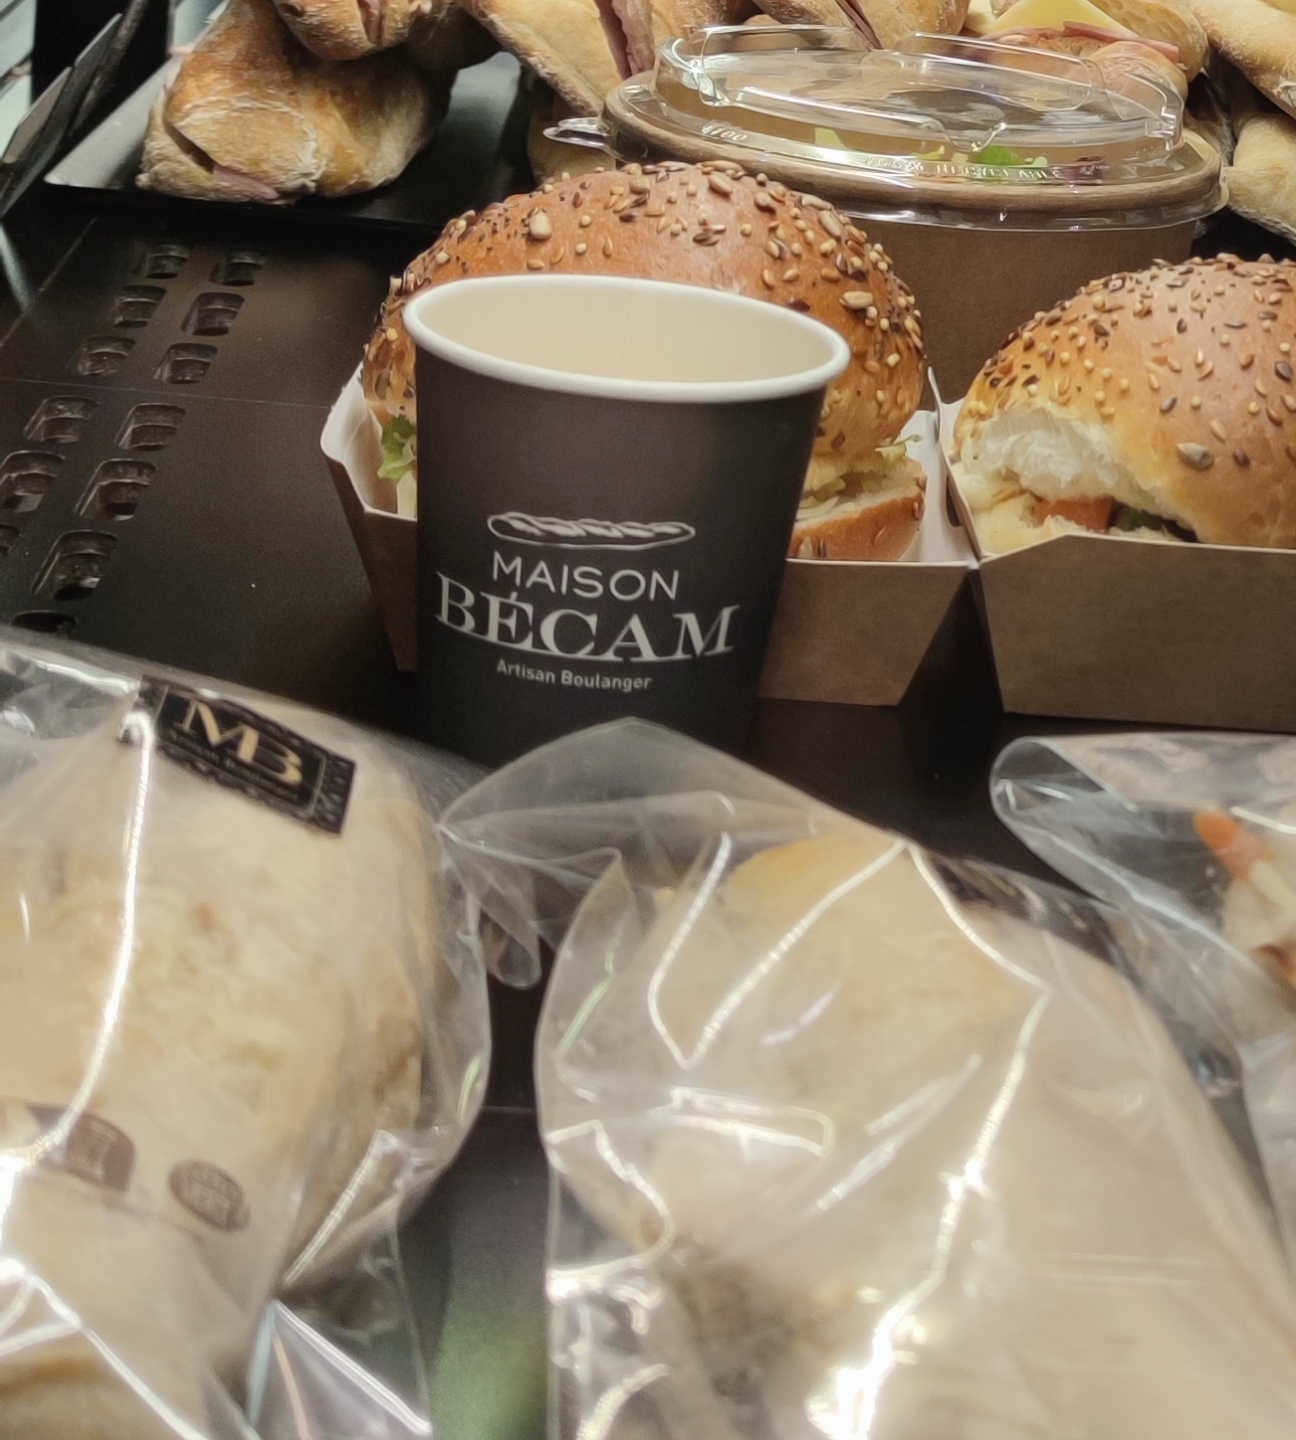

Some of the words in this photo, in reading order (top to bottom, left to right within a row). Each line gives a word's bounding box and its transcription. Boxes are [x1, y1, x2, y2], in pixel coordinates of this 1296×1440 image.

[493, 550, 680, 601] MAISON
[436, 572, 741, 662] BÉCAM
[497, 659, 556, 685] Artisan
[560, 670, 653, 693] Boulanger
[172, 700, 304, 787] MB
